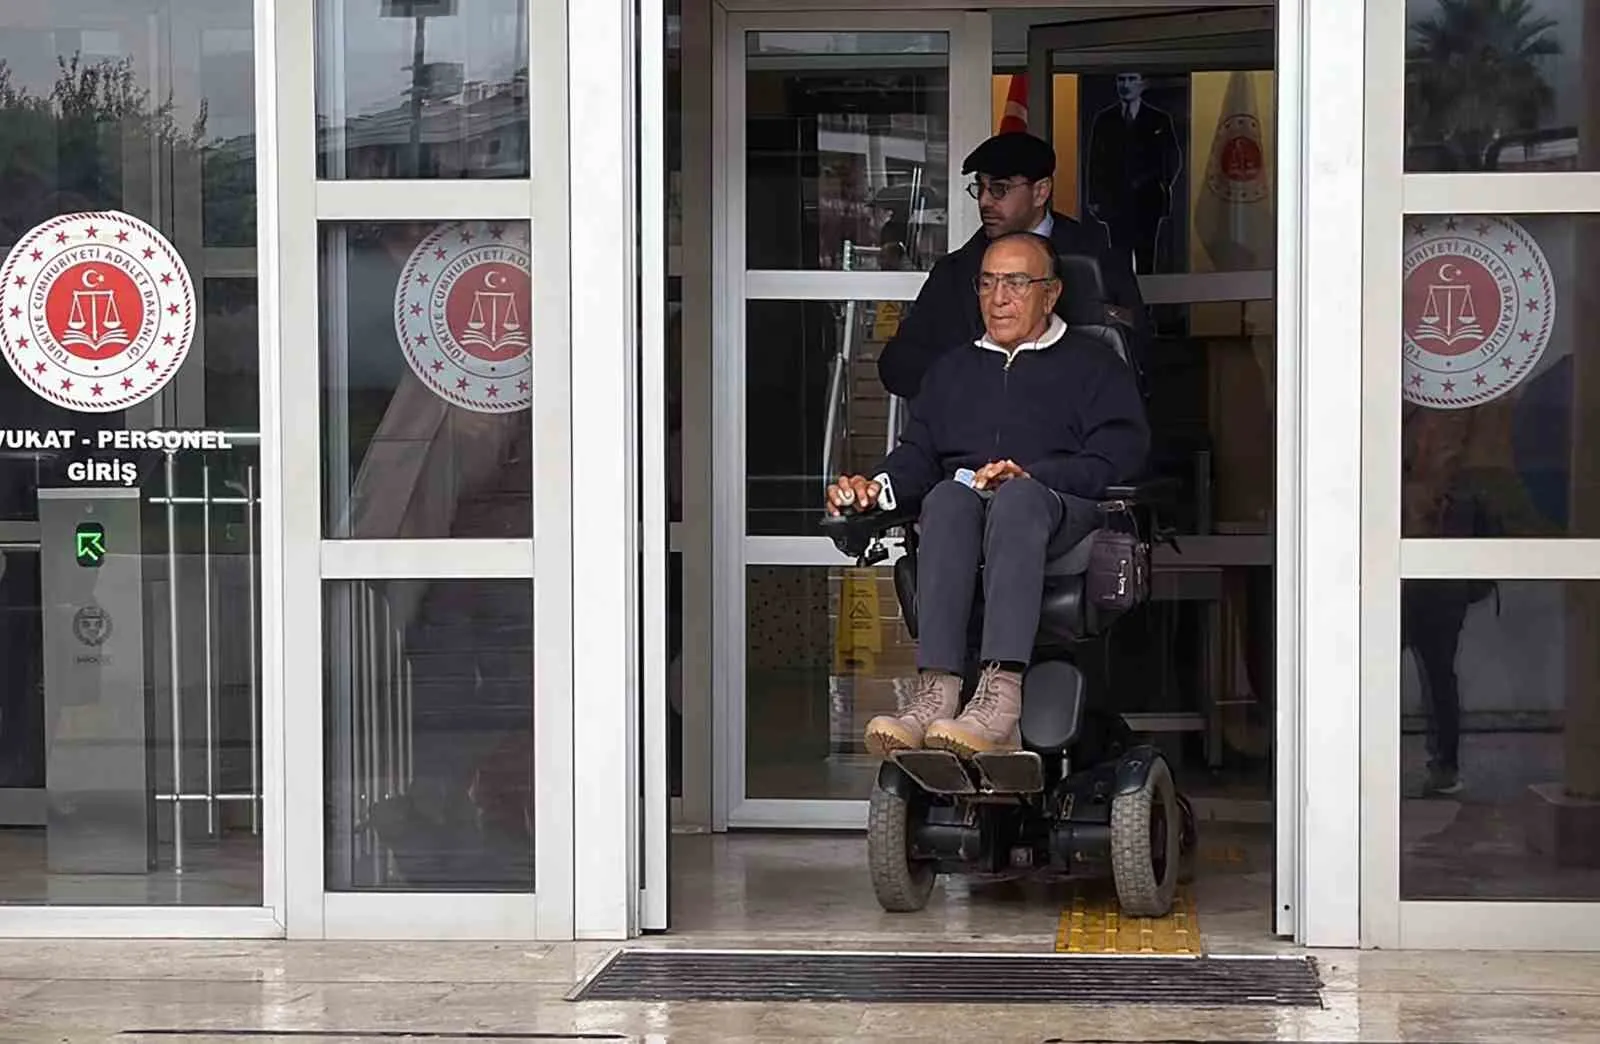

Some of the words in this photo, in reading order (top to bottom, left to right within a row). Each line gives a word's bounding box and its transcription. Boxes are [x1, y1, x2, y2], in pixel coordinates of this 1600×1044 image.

[33, 248, 100, 309] CUMHURİYETİ
[105, 251, 148, 292] ADALET
[1464, 245, 1507, 282] ADALET
[34, 314, 70, 365] TÜRKİYE
[128, 291, 157, 361] BAKANLIĞI
[0, 430, 75, 449] UKAT
[98, 430, 232, 449] PERSONEL
[68, 459, 137, 486] GİRİŞ
